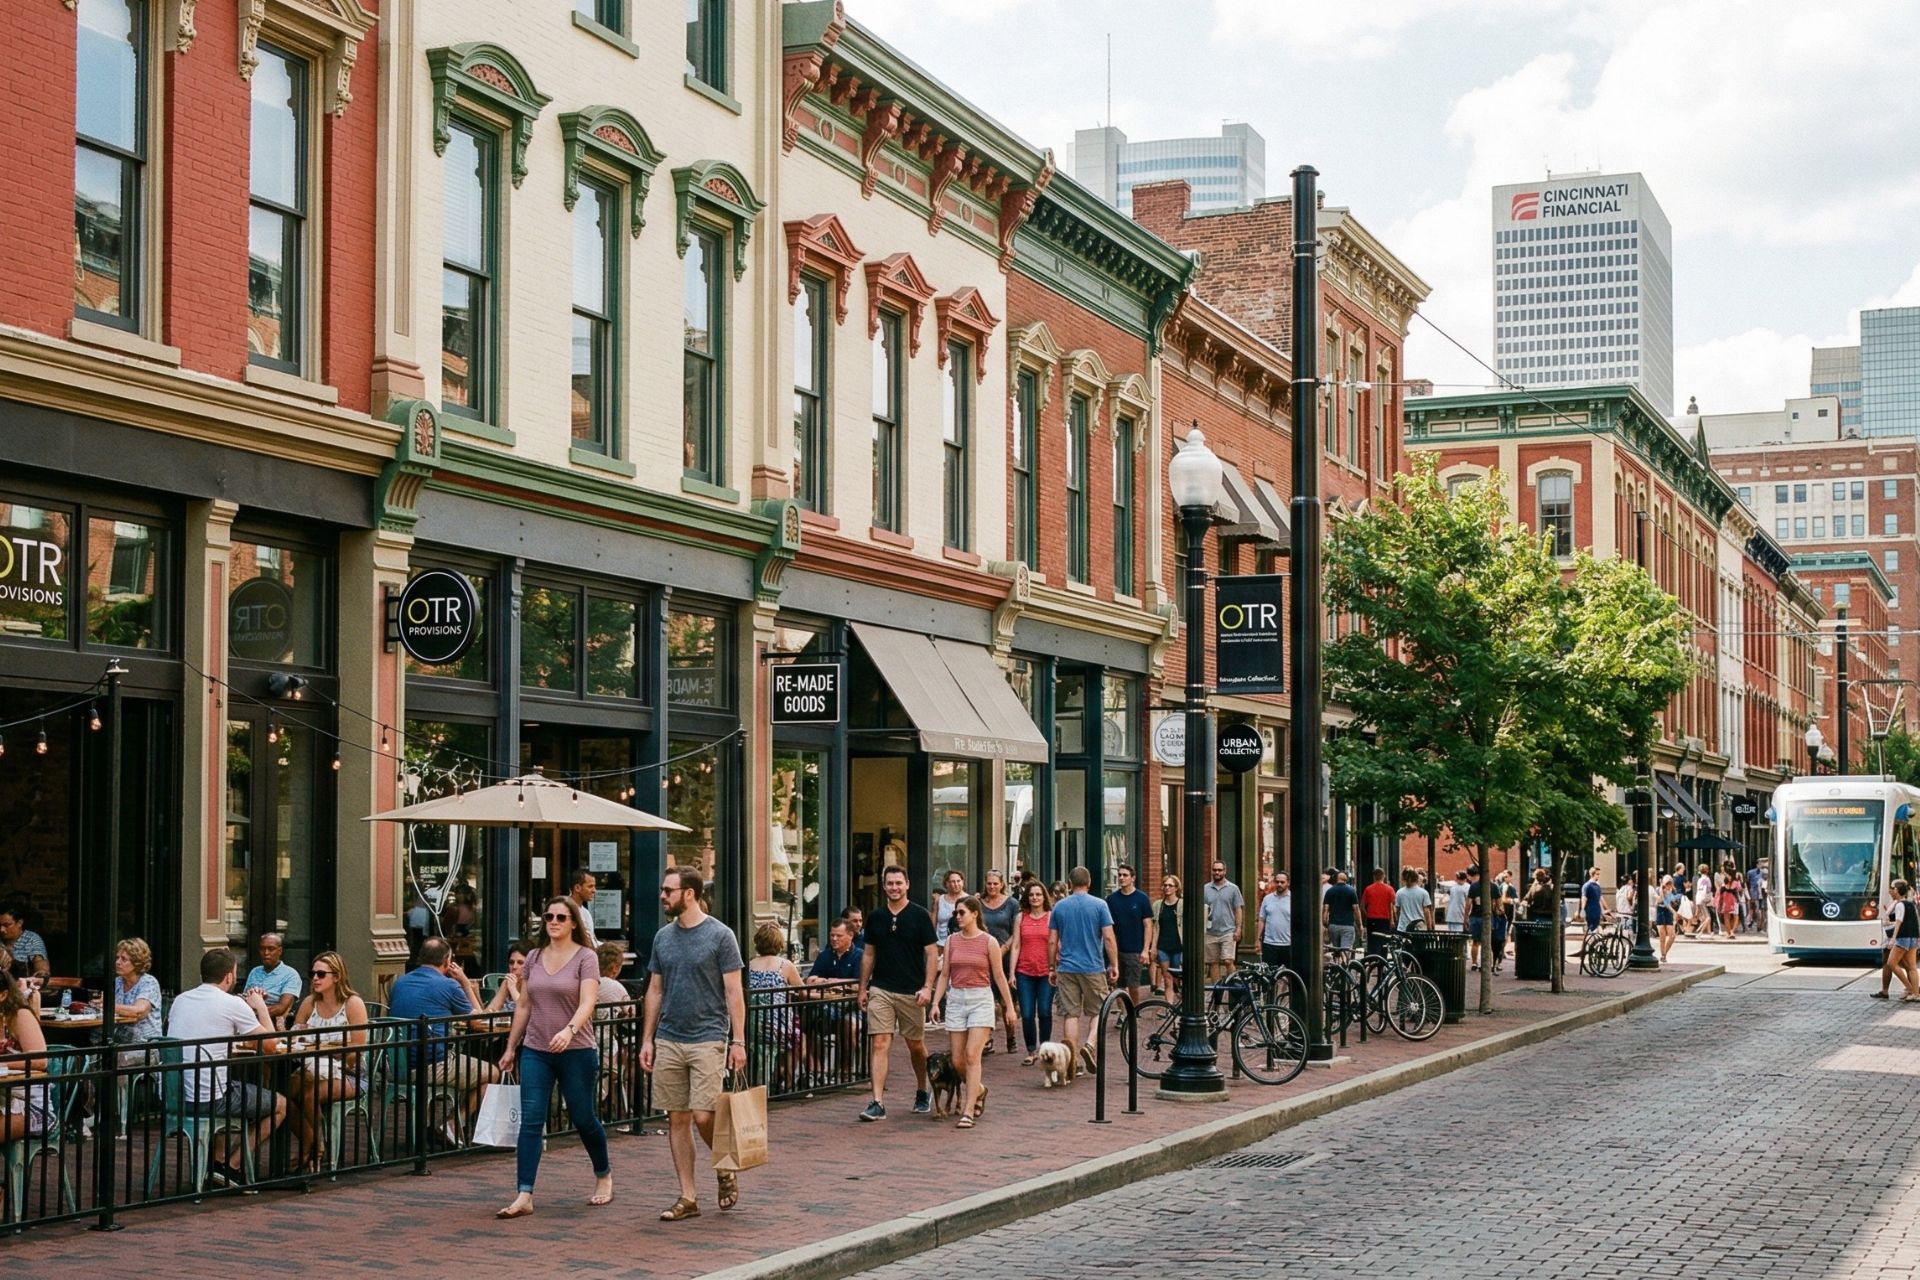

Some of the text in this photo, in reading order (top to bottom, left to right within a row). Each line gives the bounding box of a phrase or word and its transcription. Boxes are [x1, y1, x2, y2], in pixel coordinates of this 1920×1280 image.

[1543, 184, 1629, 203] CINCINNATI
[1542, 200, 1622, 218] FINANCIAL
[407, 597, 462, 624] OTR
[1219, 603, 1278, 630] OTR
[408, 625, 462, 636] PROVISIONS
[776, 674, 834, 692] RE-MADE
[784, 695, 826, 713] GOODS
[1223, 738, 1257, 748] URBAN
